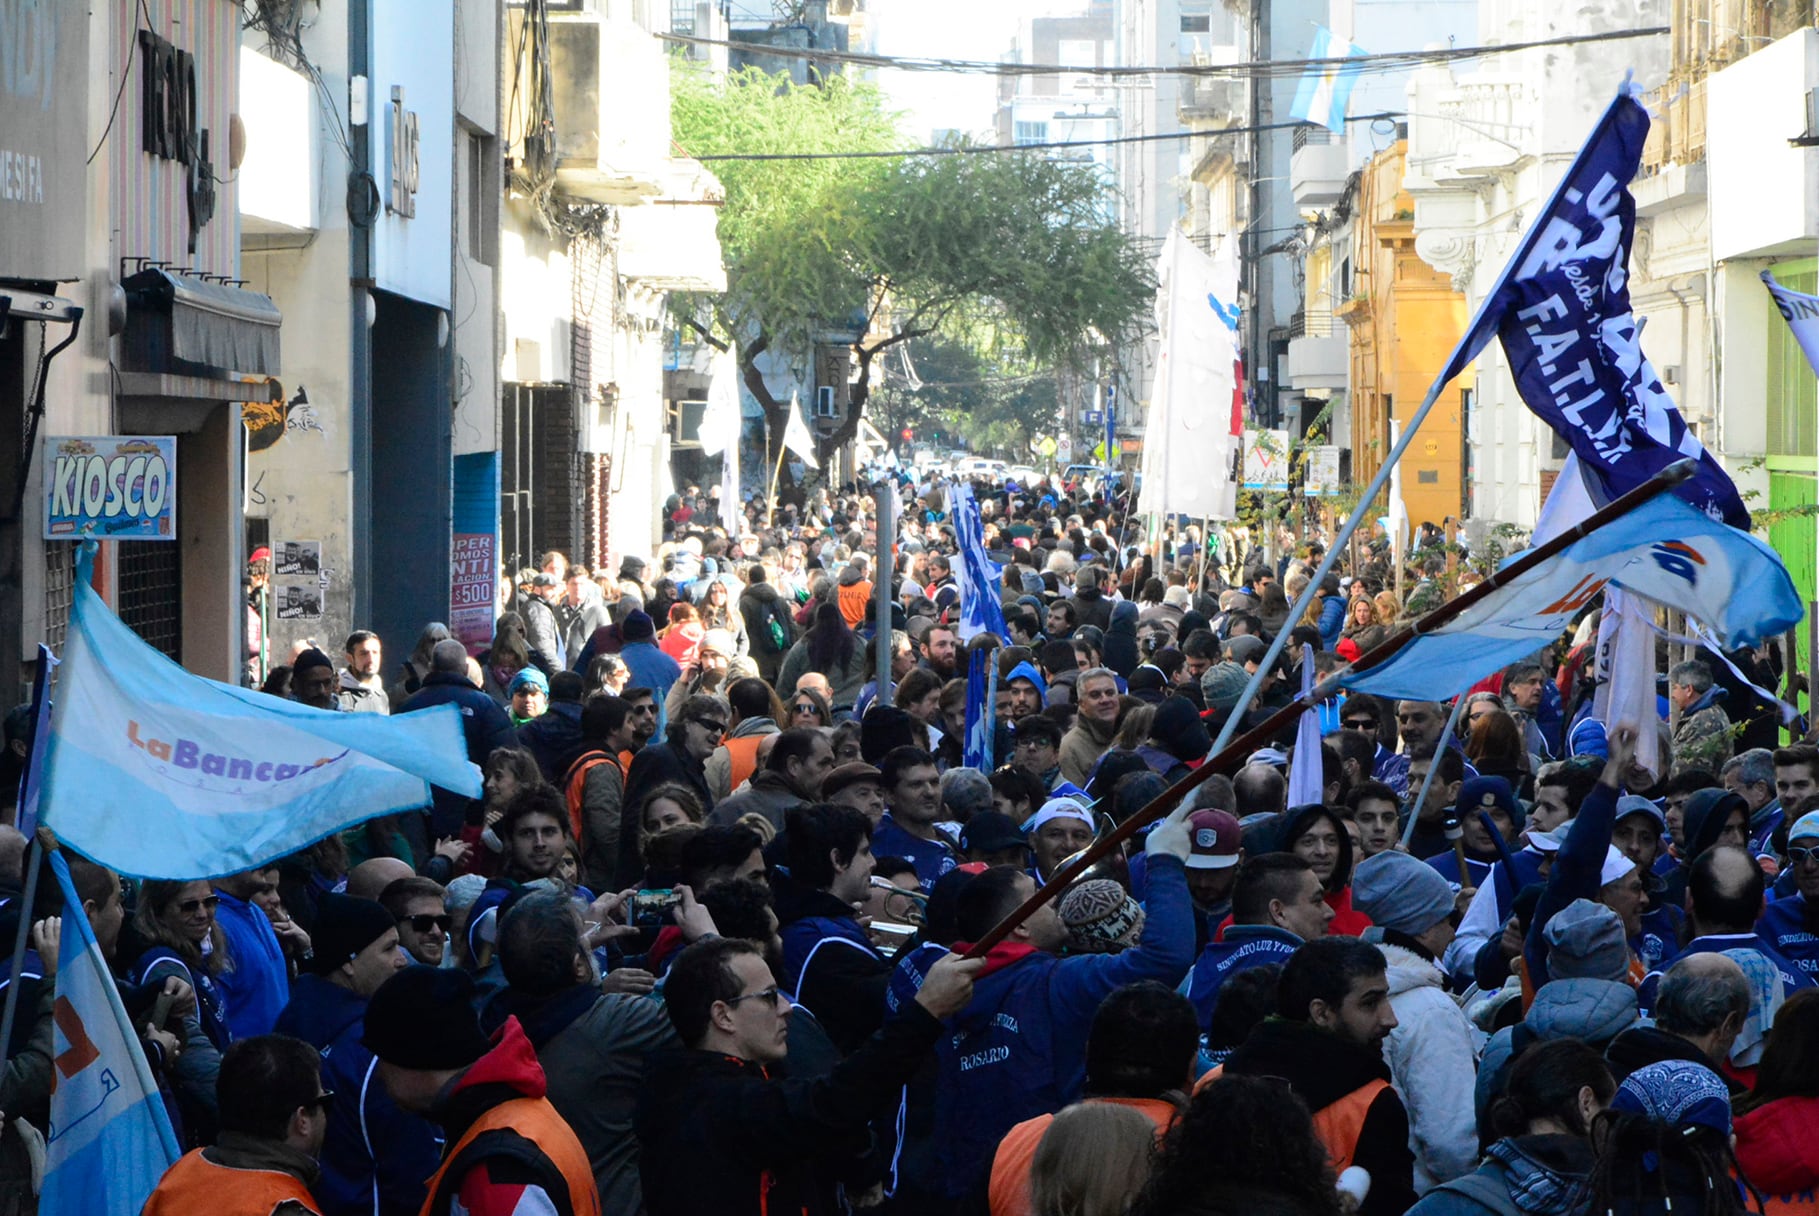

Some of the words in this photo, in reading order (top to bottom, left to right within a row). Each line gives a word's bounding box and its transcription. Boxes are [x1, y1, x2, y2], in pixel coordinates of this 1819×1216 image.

[51, 455, 167, 518] KIOSCO
[1256, 940, 1273, 952] LUZ
[1273, 940, 1281, 952] Y
[959, 1045, 1010, 1072] ROSARIO
